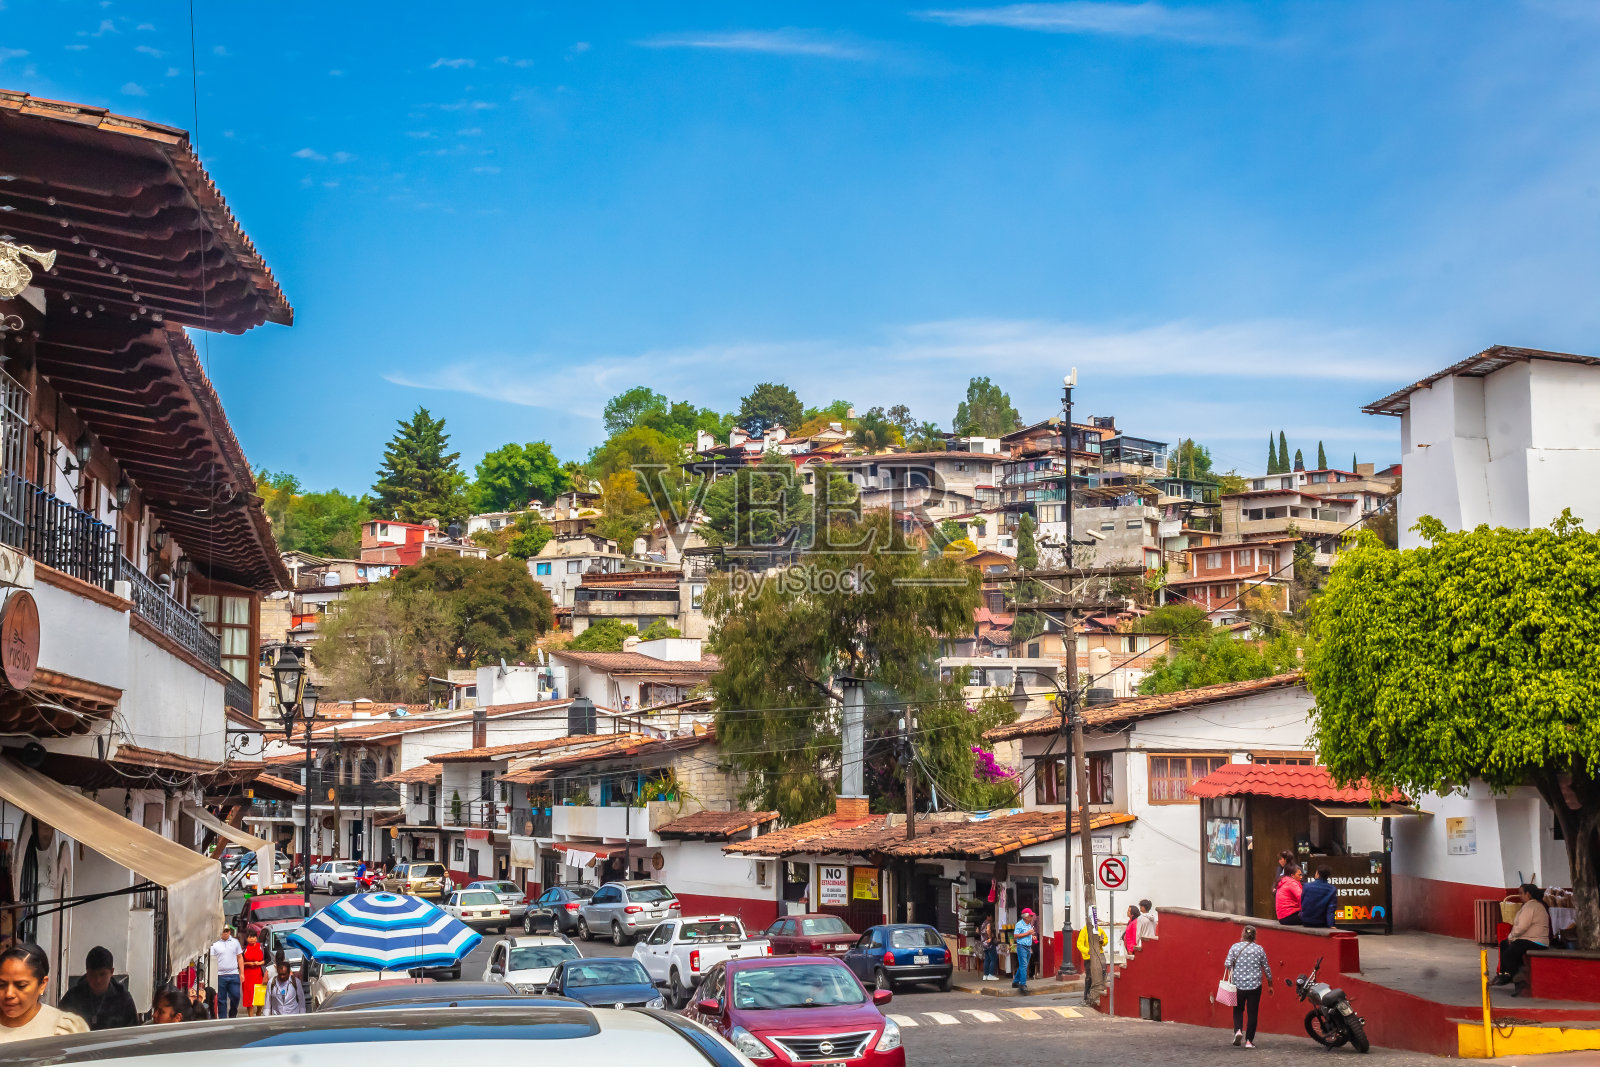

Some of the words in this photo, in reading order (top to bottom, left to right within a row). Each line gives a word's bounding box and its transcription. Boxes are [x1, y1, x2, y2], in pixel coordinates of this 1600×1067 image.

[826, 869, 841, 879] NO
[1307, 876, 1378, 884] IORMACIÓN
[1344, 906, 1385, 919] BRAVO
